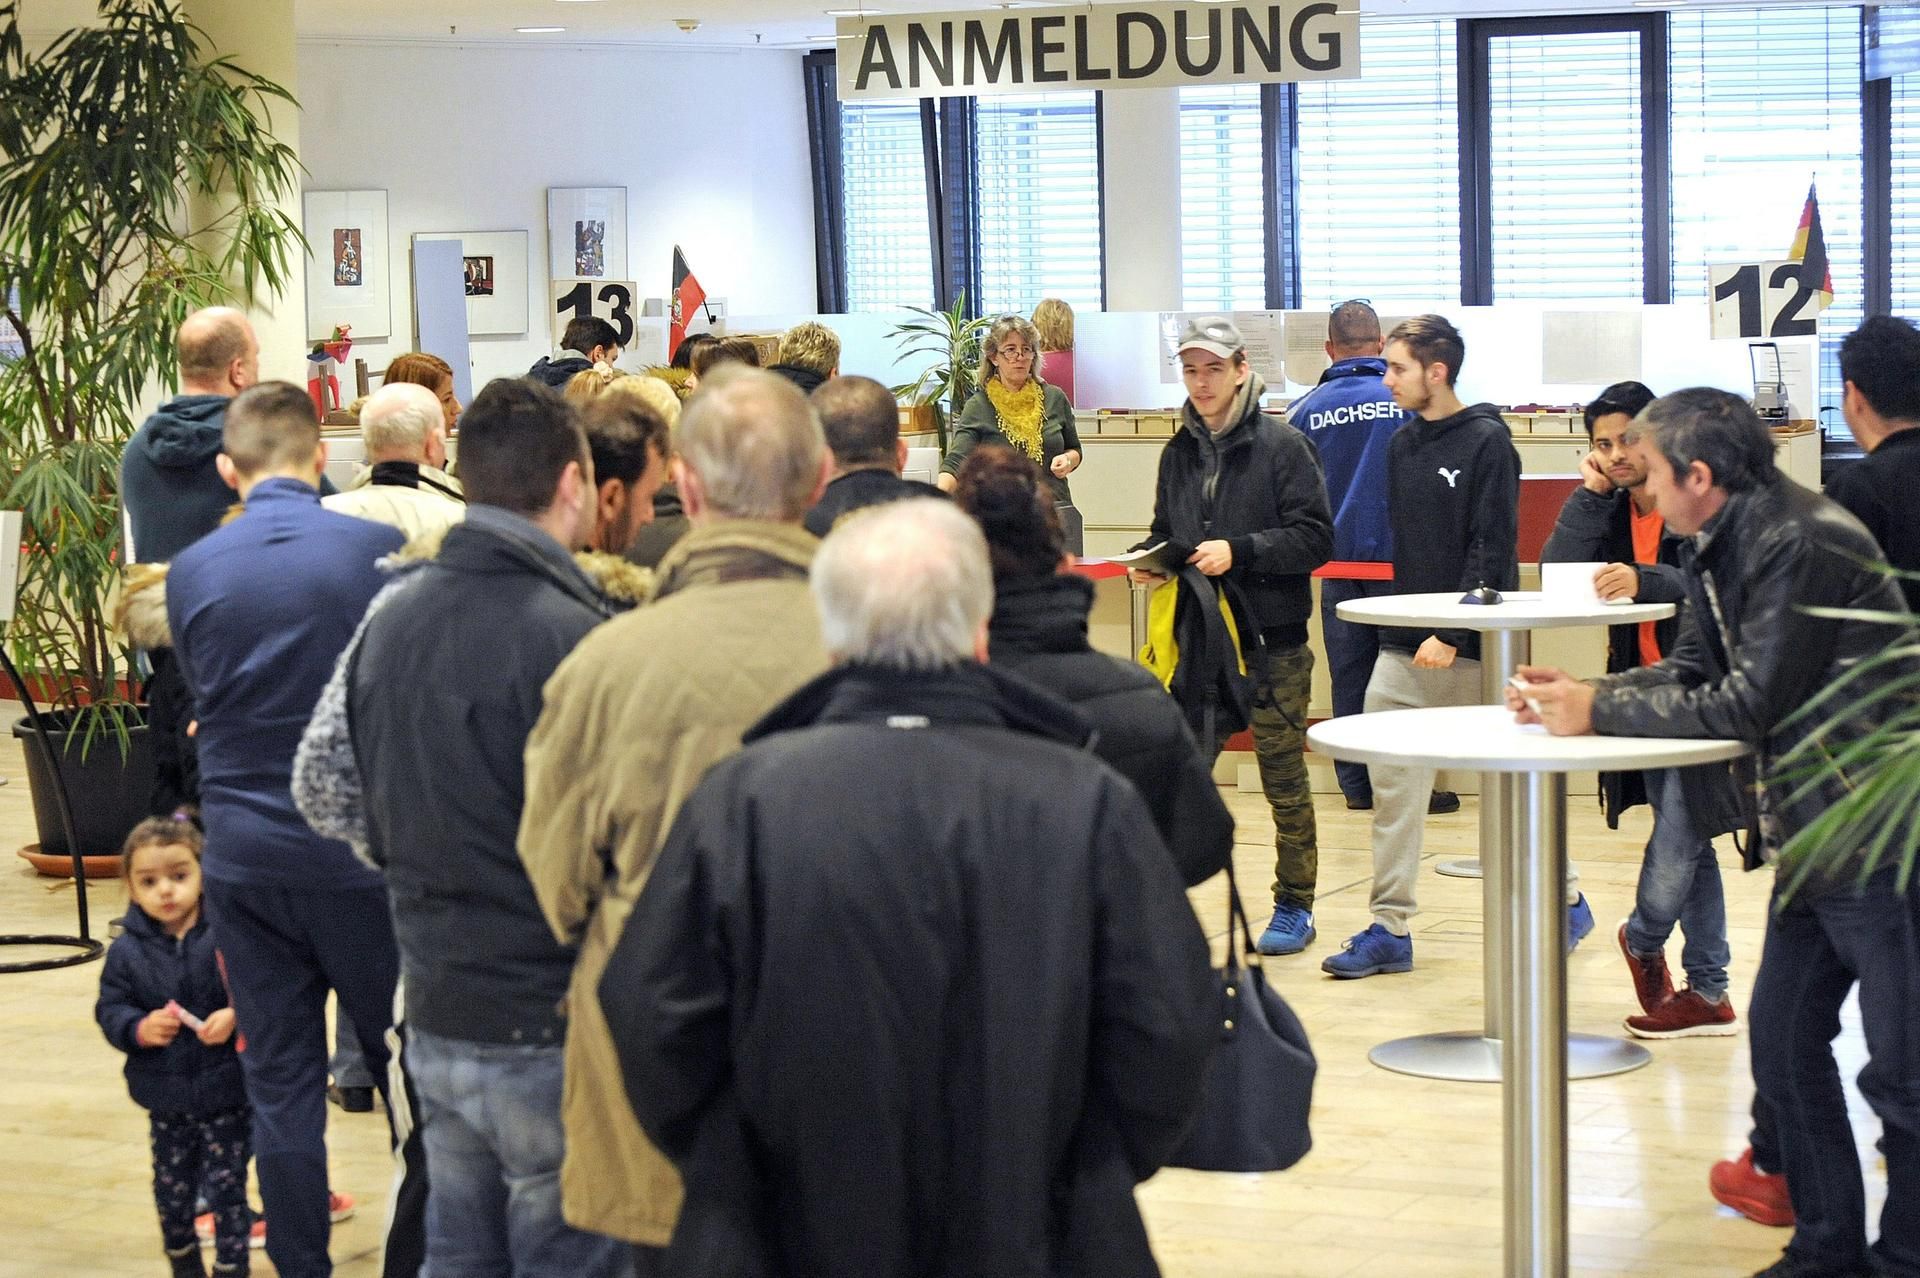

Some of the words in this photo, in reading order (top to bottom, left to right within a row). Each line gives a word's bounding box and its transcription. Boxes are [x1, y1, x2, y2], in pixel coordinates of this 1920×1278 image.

[855, 3, 1341, 90] ANMELDUNG
[557, 282, 633, 346] 13
[1715, 264, 1817, 337] 12
[1310, 401, 1404, 430] DACHSER
